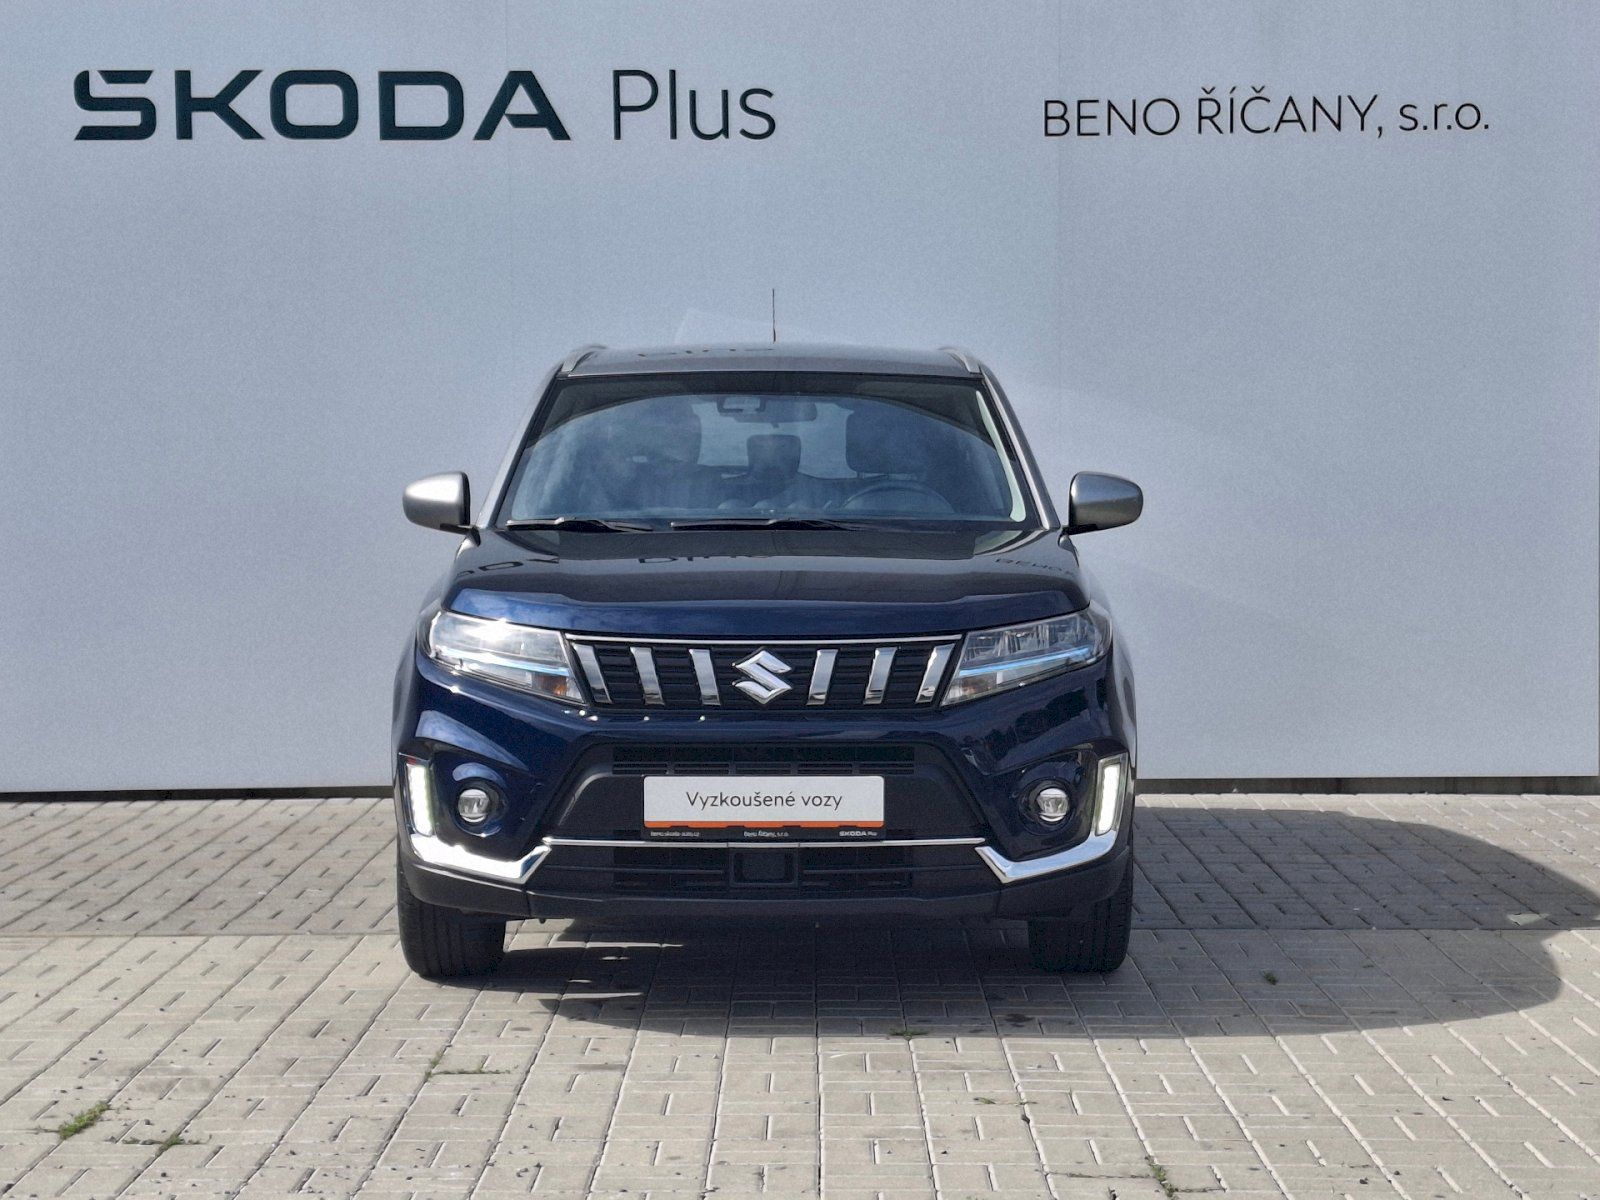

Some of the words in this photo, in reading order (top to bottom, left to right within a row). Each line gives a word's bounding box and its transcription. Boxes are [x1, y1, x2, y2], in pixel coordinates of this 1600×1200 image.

[613, 68, 777, 141] Plus
[1043, 97, 1181, 138] BENO
[1197, 85, 1383, 139] ŘÍČANY,
[1398, 102, 1490, 132] s.r.o.
[686, 791, 796, 811] Vyzkoušené
[801, 795, 843, 811] vozy
